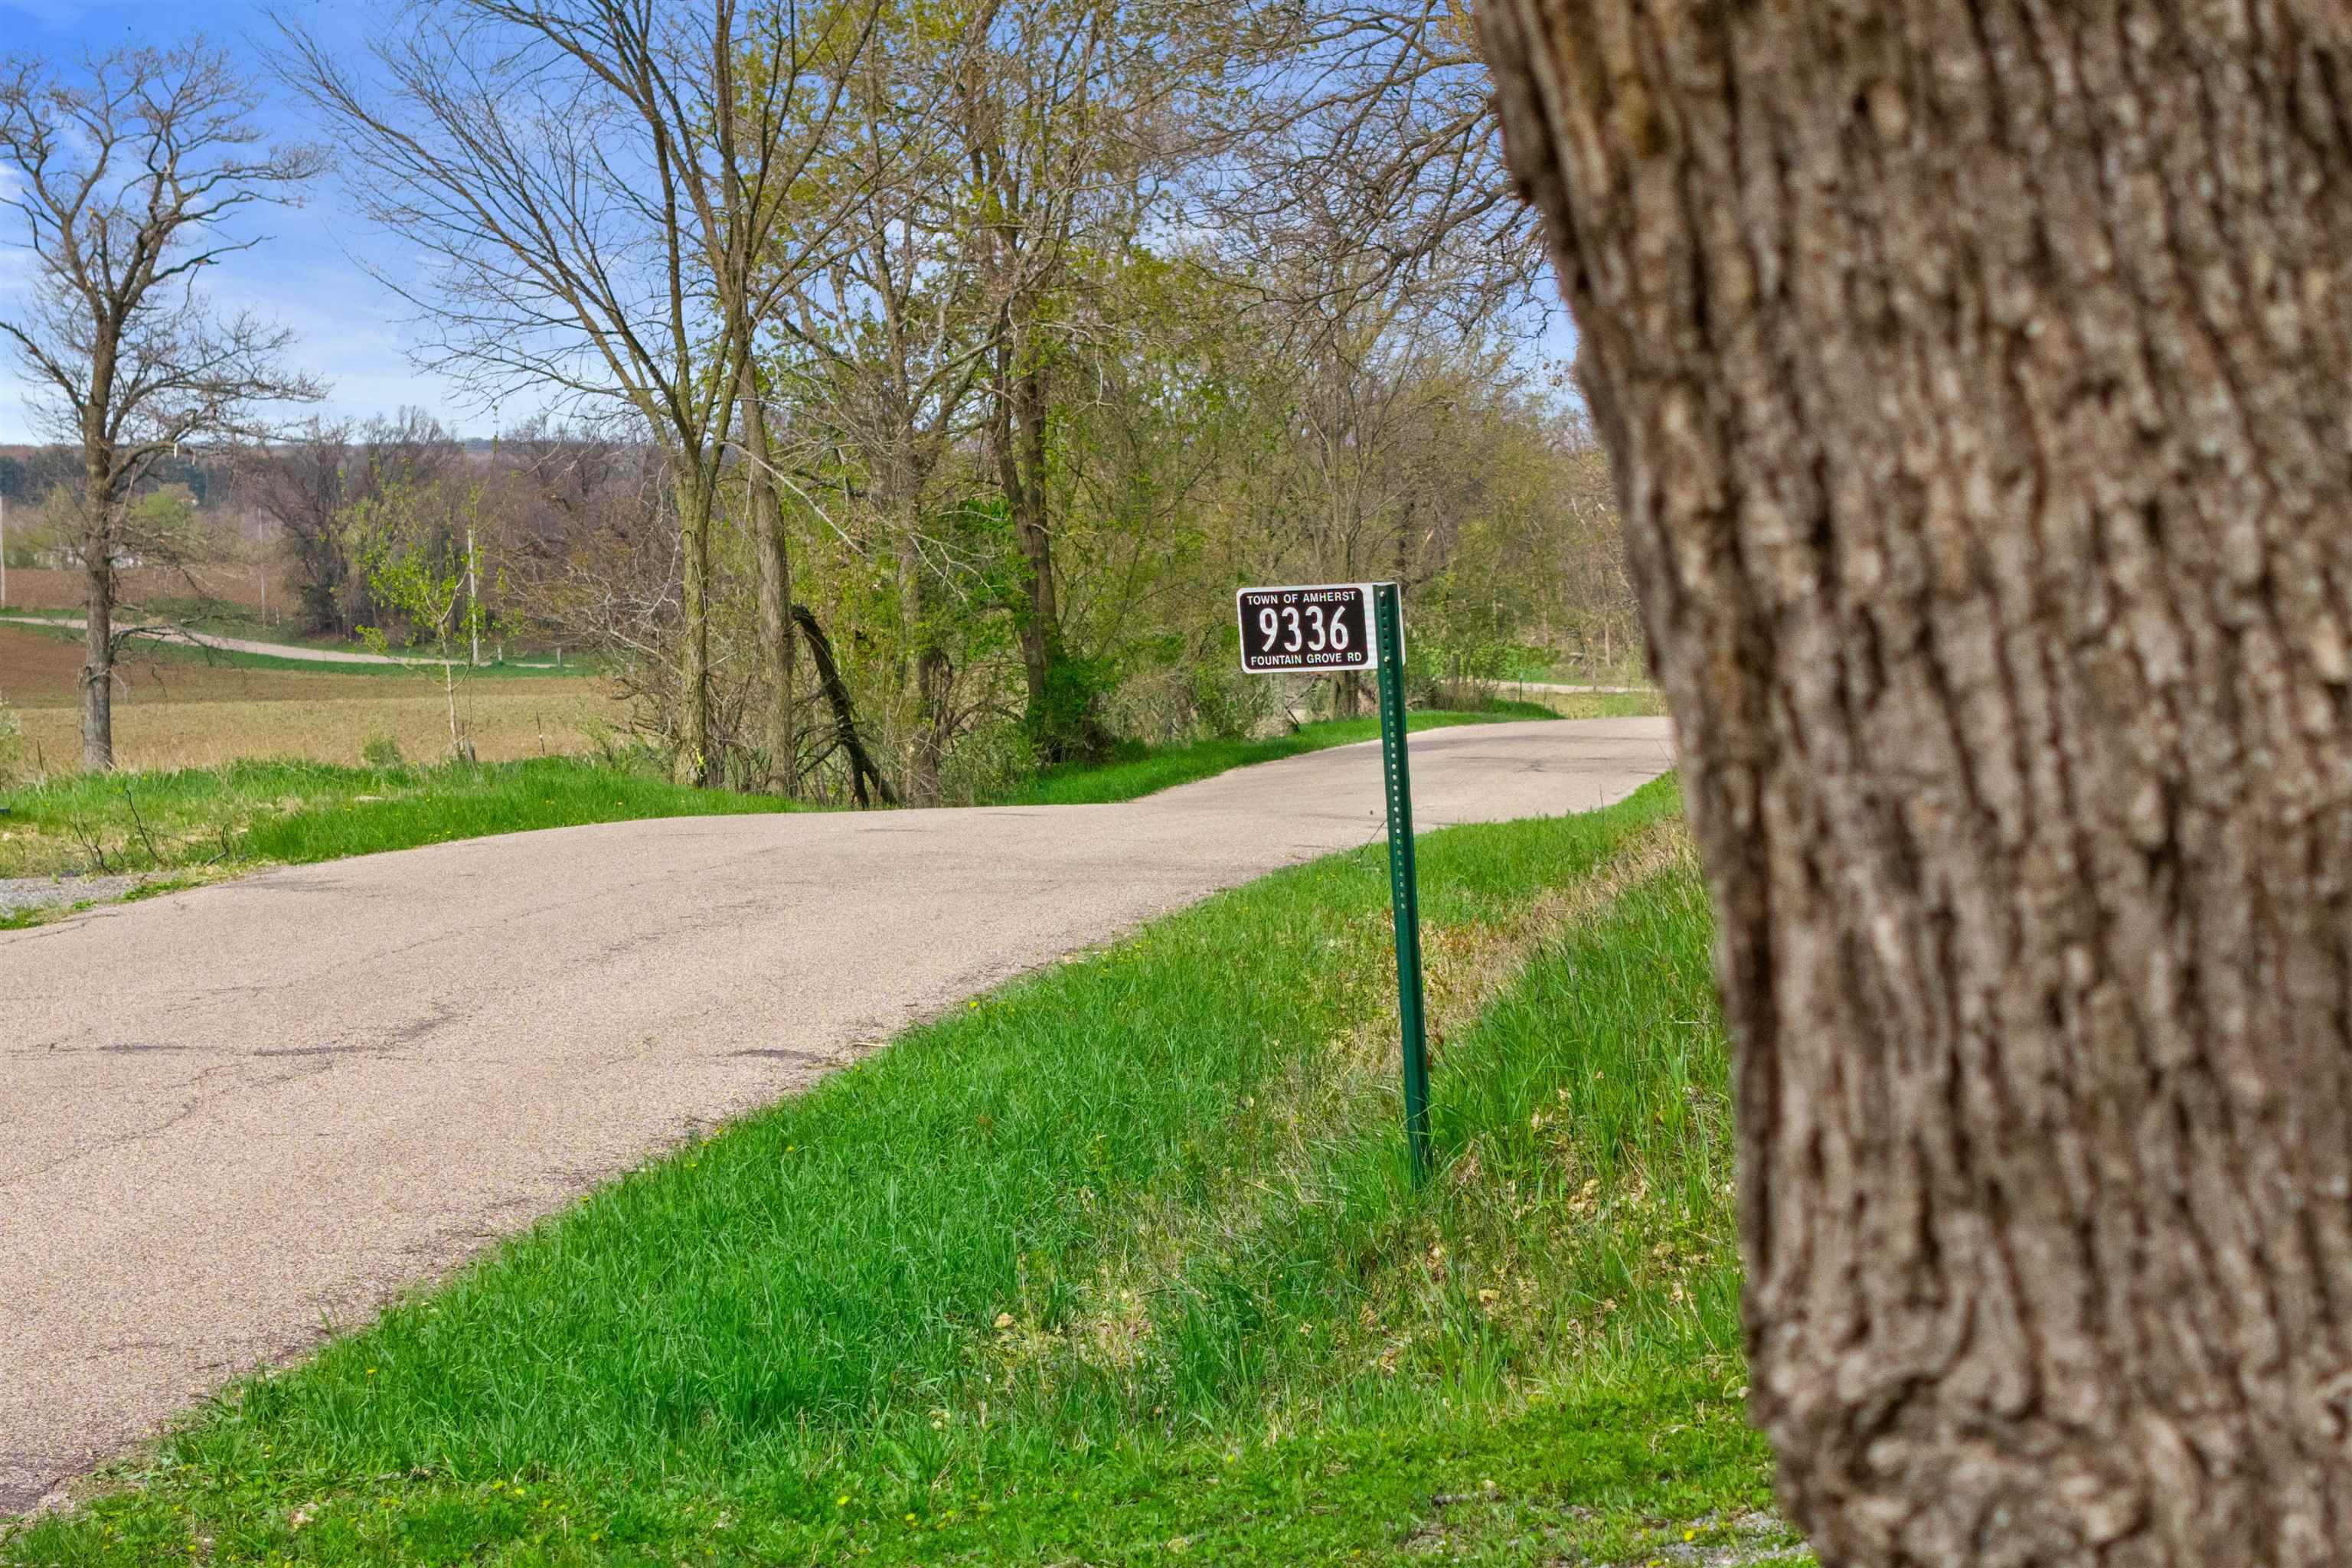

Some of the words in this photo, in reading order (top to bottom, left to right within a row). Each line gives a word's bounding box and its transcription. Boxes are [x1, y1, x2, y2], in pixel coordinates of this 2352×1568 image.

[1246, 595, 1278, 605] TOWN
[1283, 593, 1298, 603] OF
[1303, 591, 1356, 603] AMHERST
[1259, 605, 1349, 652] 9336
[1251, 655, 1302, 666] FOUNTAIN
[1307, 652, 1342, 664] GROVE
[1347, 652, 1361, 662] RD
